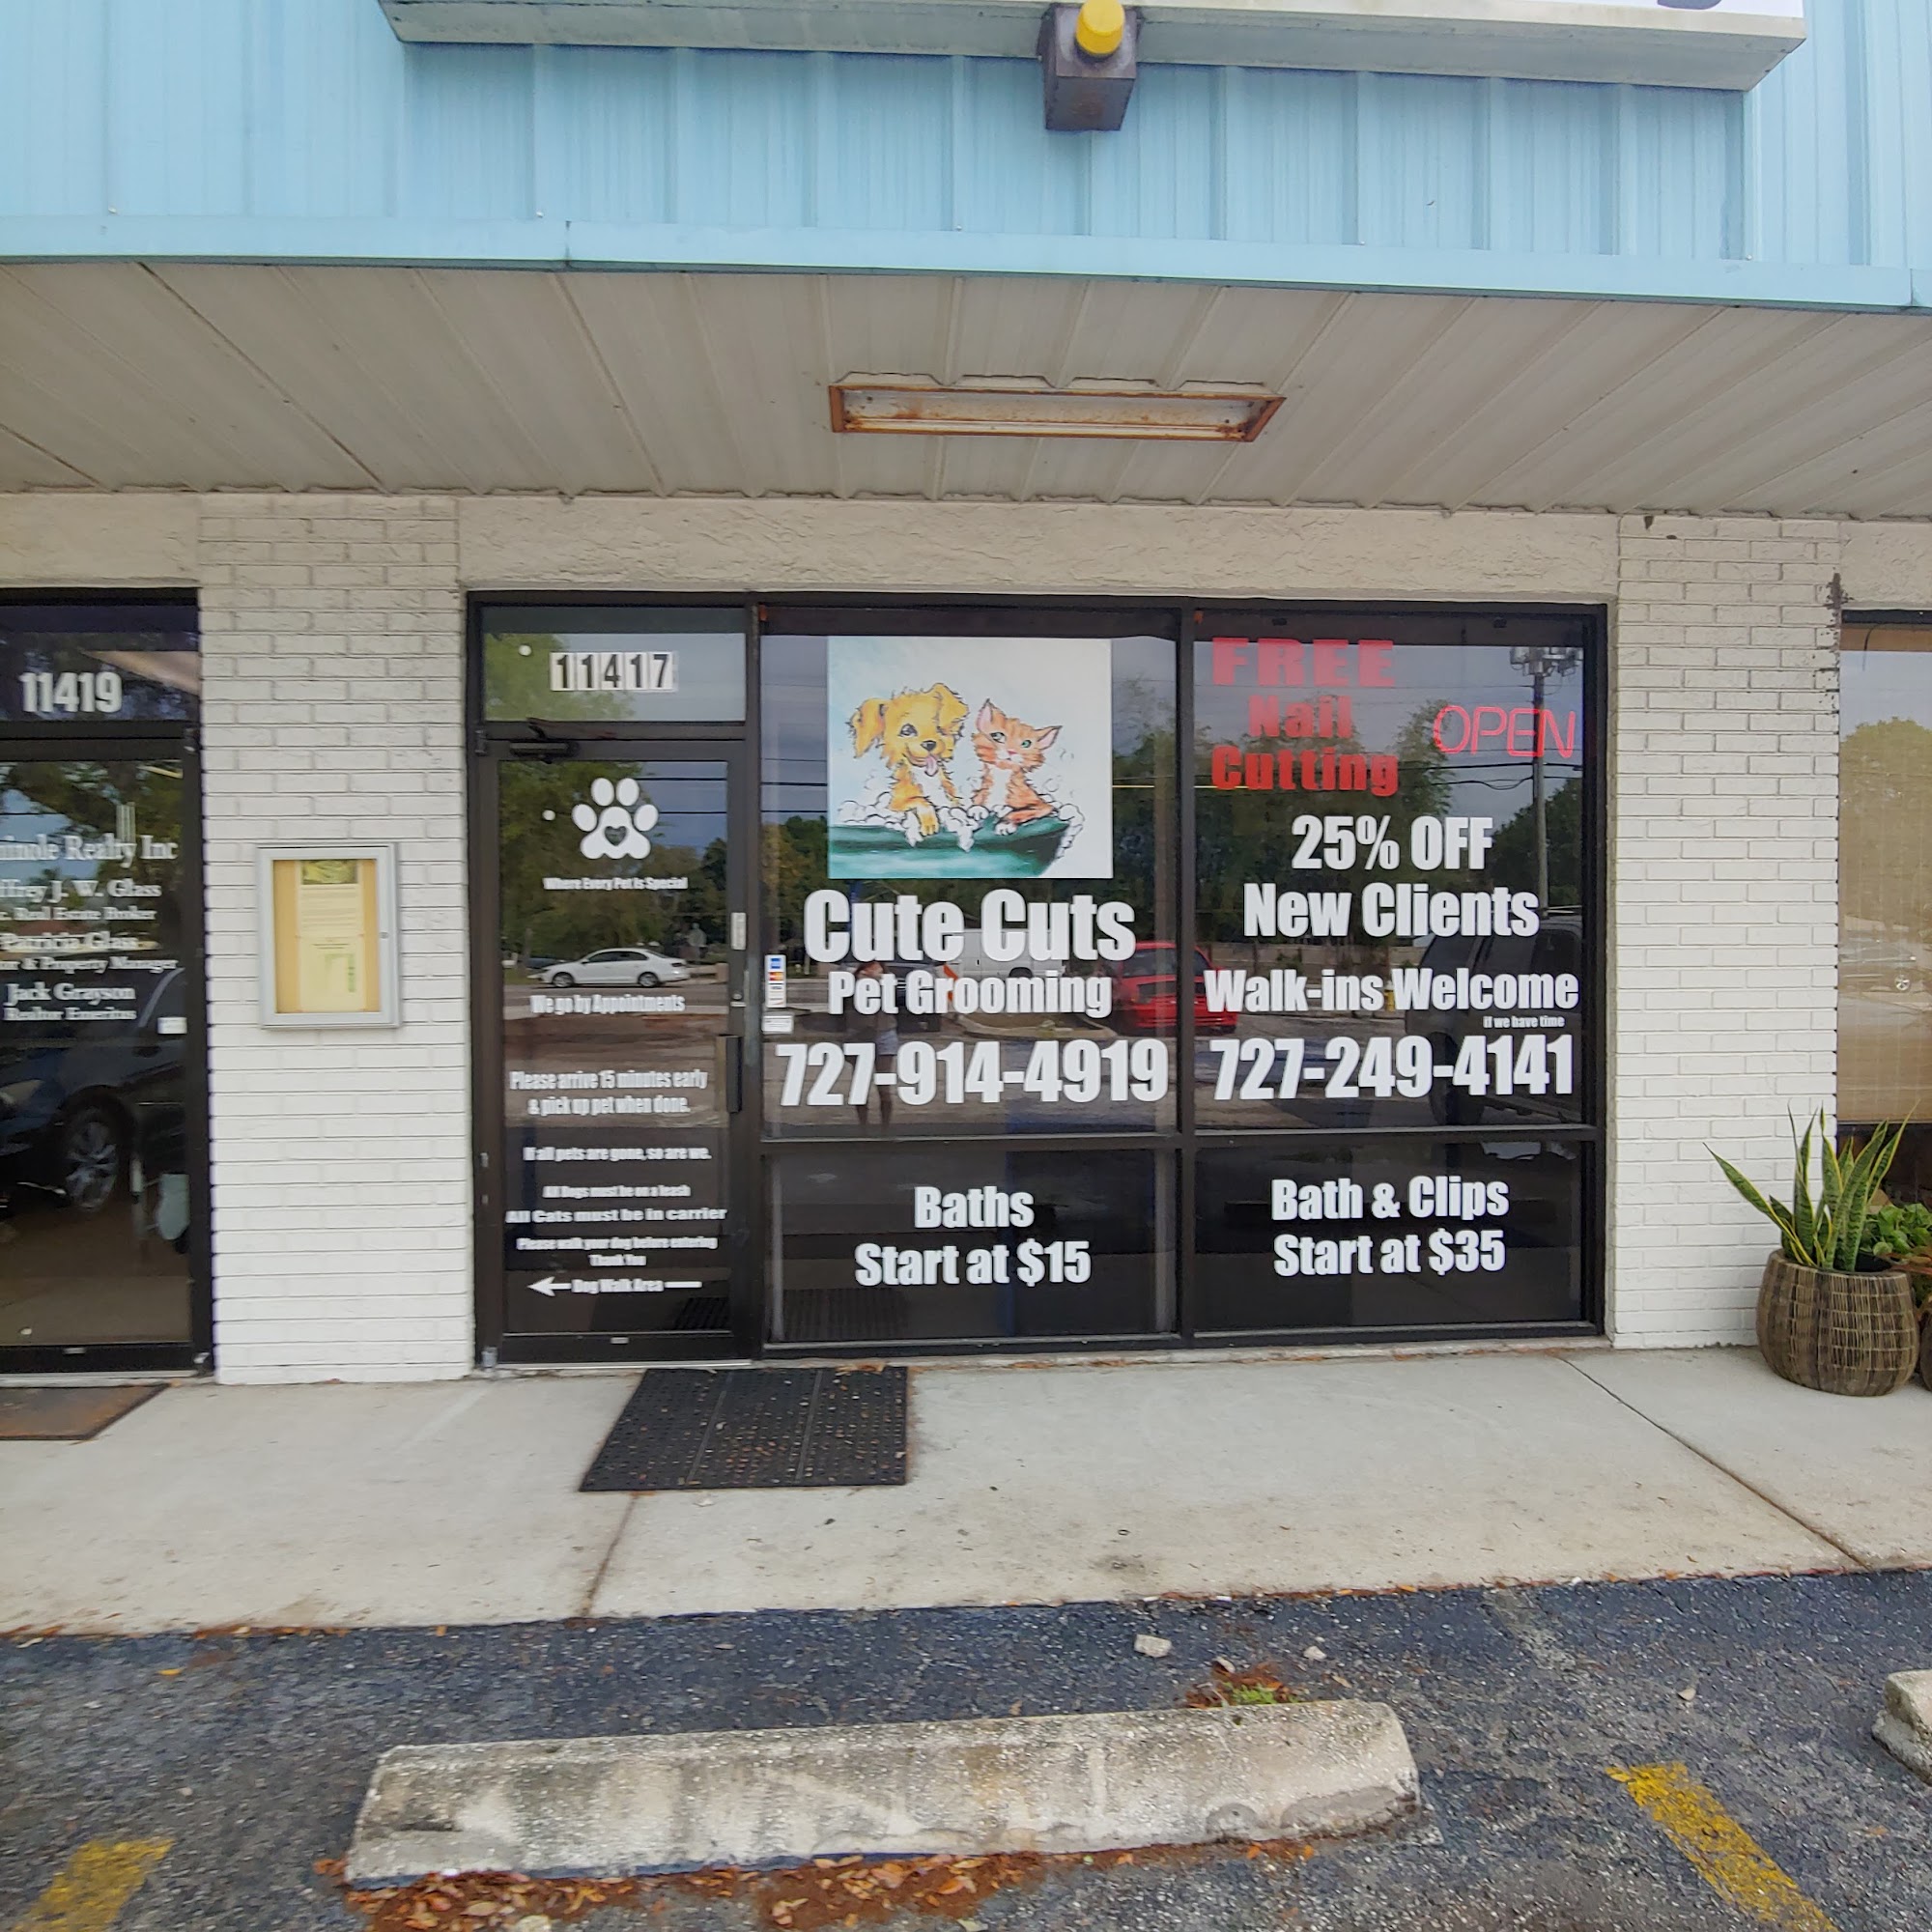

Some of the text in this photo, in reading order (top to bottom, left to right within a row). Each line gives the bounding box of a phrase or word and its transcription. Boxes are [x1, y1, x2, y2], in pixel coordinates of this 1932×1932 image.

[556, 653, 668, 689] 11417
[1211, 637, 1395, 688] FREE
[19, 671, 122, 713] 11419
[1249, 695, 1353, 738] Nail
[1433, 704, 1577, 758] OPEN
[1210, 745, 1400, 798] Cutting
[63, 833, 137, 868] Realty
[139, 834, 179, 860] Inc
[1291, 814, 1493, 870] 25% OFF
[71, 880, 104, 896] W.
[106, 878, 162, 897] Glass
[804, 889, 1136, 962] Cute Cuts
[1243, 882, 1540, 937] New Clients
[83, 930, 139, 950] Glass
[3, 981, 136, 1007] Jack Grayson
[530, 994, 554, 1013] We
[554, 997, 573, 1014] go
[574, 994, 592, 1014] by
[828, 970, 898, 1015] Pet
[905, 969, 1112, 1018] Grooming
[1204, 967, 1579, 1012] Walk-ins Welcome
[1493, 1017, 1510, 1028] we
[1511, 1015, 1538, 1028] have
[1539, 1014, 1565, 1028] time
[509, 1068, 709, 1090] Please arrive 15 minutes early
[776, 1038, 1169, 1106] 727-914-4919
[1209, 1034, 1574, 1100] 727-249-4141
[540, 1096, 571, 1116] pick
[571, 1097, 590, 1116] up
[591, 1096, 614, 1116] pet
[615, 1094, 652, 1114] when
[505, 1208, 727, 1223] All Cats must be in carrier
[914, 1185, 1036, 1228] Baths
[1271, 1176, 1510, 1220] Bath & Clips
[855, 1237, 1092, 1287] Start at $15
[1273, 1228, 1506, 1277] Start at $35
